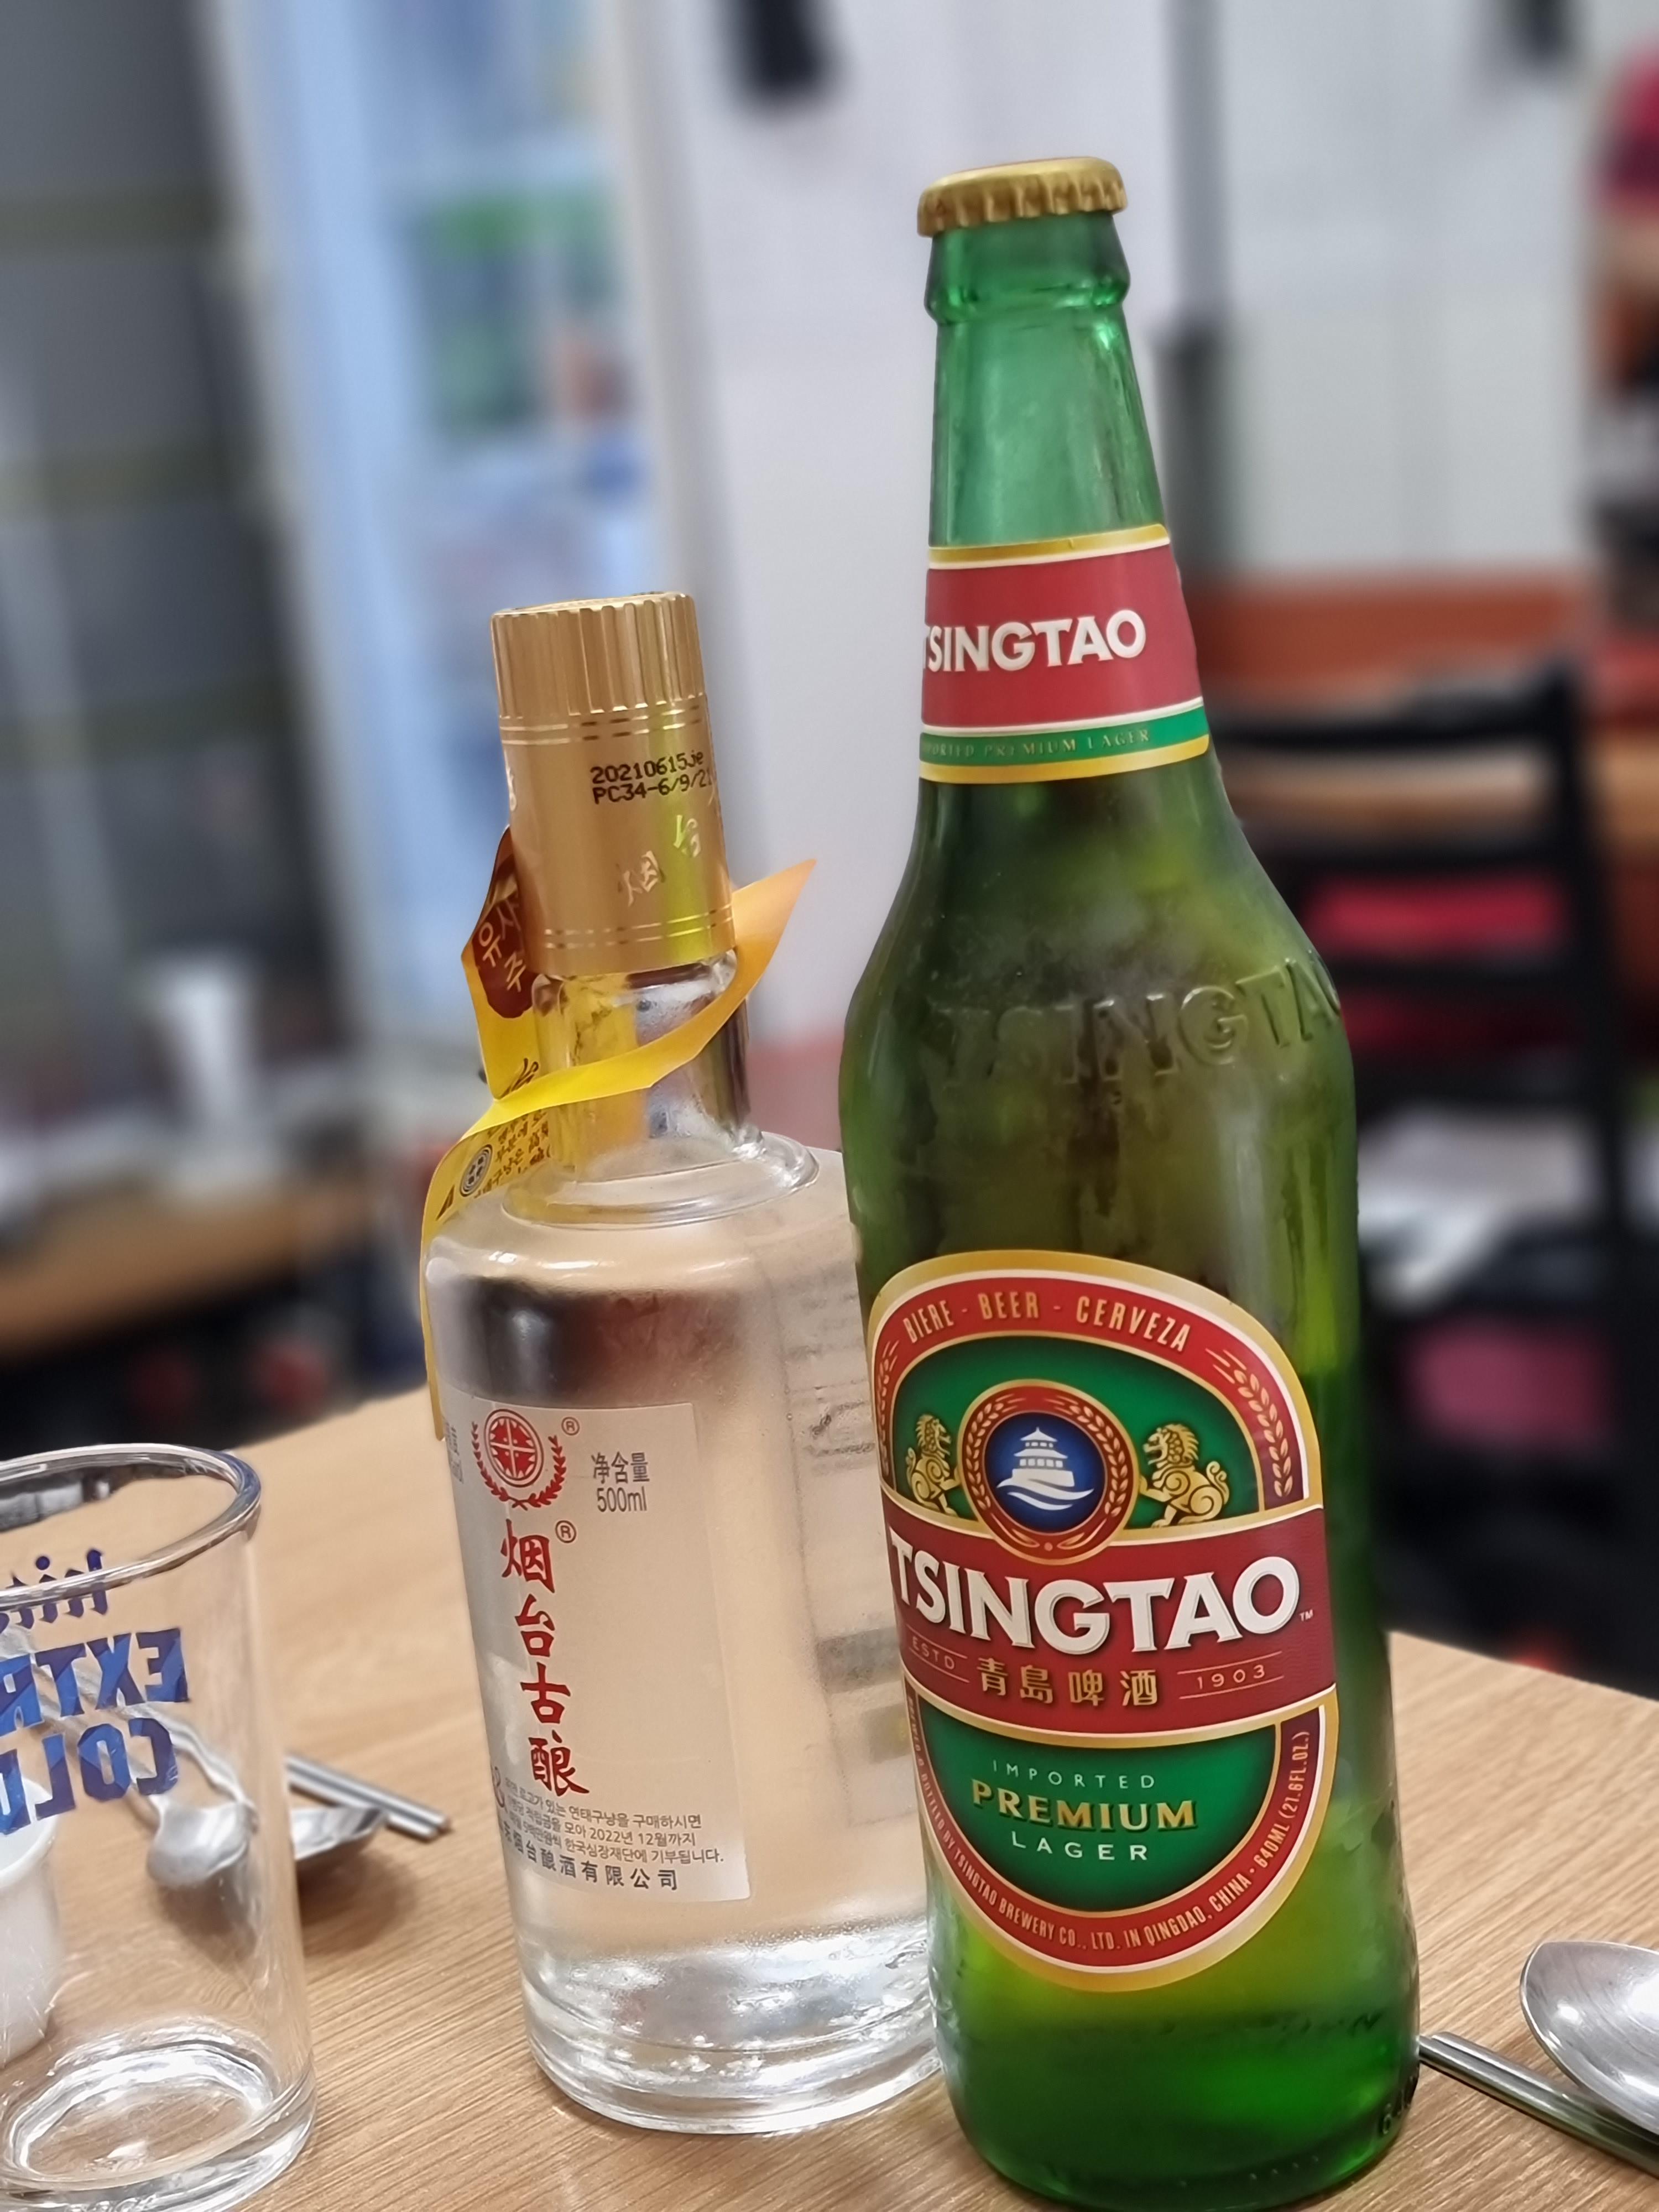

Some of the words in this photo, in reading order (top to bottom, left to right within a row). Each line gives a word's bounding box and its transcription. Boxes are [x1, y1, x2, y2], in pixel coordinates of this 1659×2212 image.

[589, 750, 704, 785] 20210615je
[902, 1300, 954, 1344] BIERE
[977, 1291, 1039, 1320] BEER
[1076, 1295, 1191, 1352] CERVEZA
[591, 1451, 650, 1484] 净含量
[596, 1486, 648, 1513] 500ml
[889, 1526, 1300, 1655] TSINGTAO
[500, 1518, 590, 1797] 烟台古酿
[912, 1636, 956, 1670] ESTD
[976, 1657, 1158, 1708] 青島啤酒
[1197, 1664, 1265, 1690] 1903
[993, 1759, 1155, 1789] IMPORTED
[971, 1778, 1196, 1830] PREMIUM
[564, 1822, 587, 1838] 모아
[589, 1827, 633, 1845] 2022년
[638, 1832, 696, 1848] 12월까지
[632, 1814, 702, 1829] 구매하시면
[564, 1838, 648, 1864] 한국심장재단에
[650, 1848, 724, 1864] 기부됩니다.
[921, 1773, 945, 1830] BOTTLED
[942, 1829, 956, 1850] BY
[953, 1847, 998, 1906] TSINGTAO
[998, 1897, 1056, 1940] BREWERY
[1091, 1931, 1121, 1950] LTD.
[1123, 1929, 1142, 1948] IN
[1208, 1872, 1252, 1912] CHINA
[1253, 1823, 1290, 1868] 640ML
[1011, 1830, 1147, 1861] LAGER
